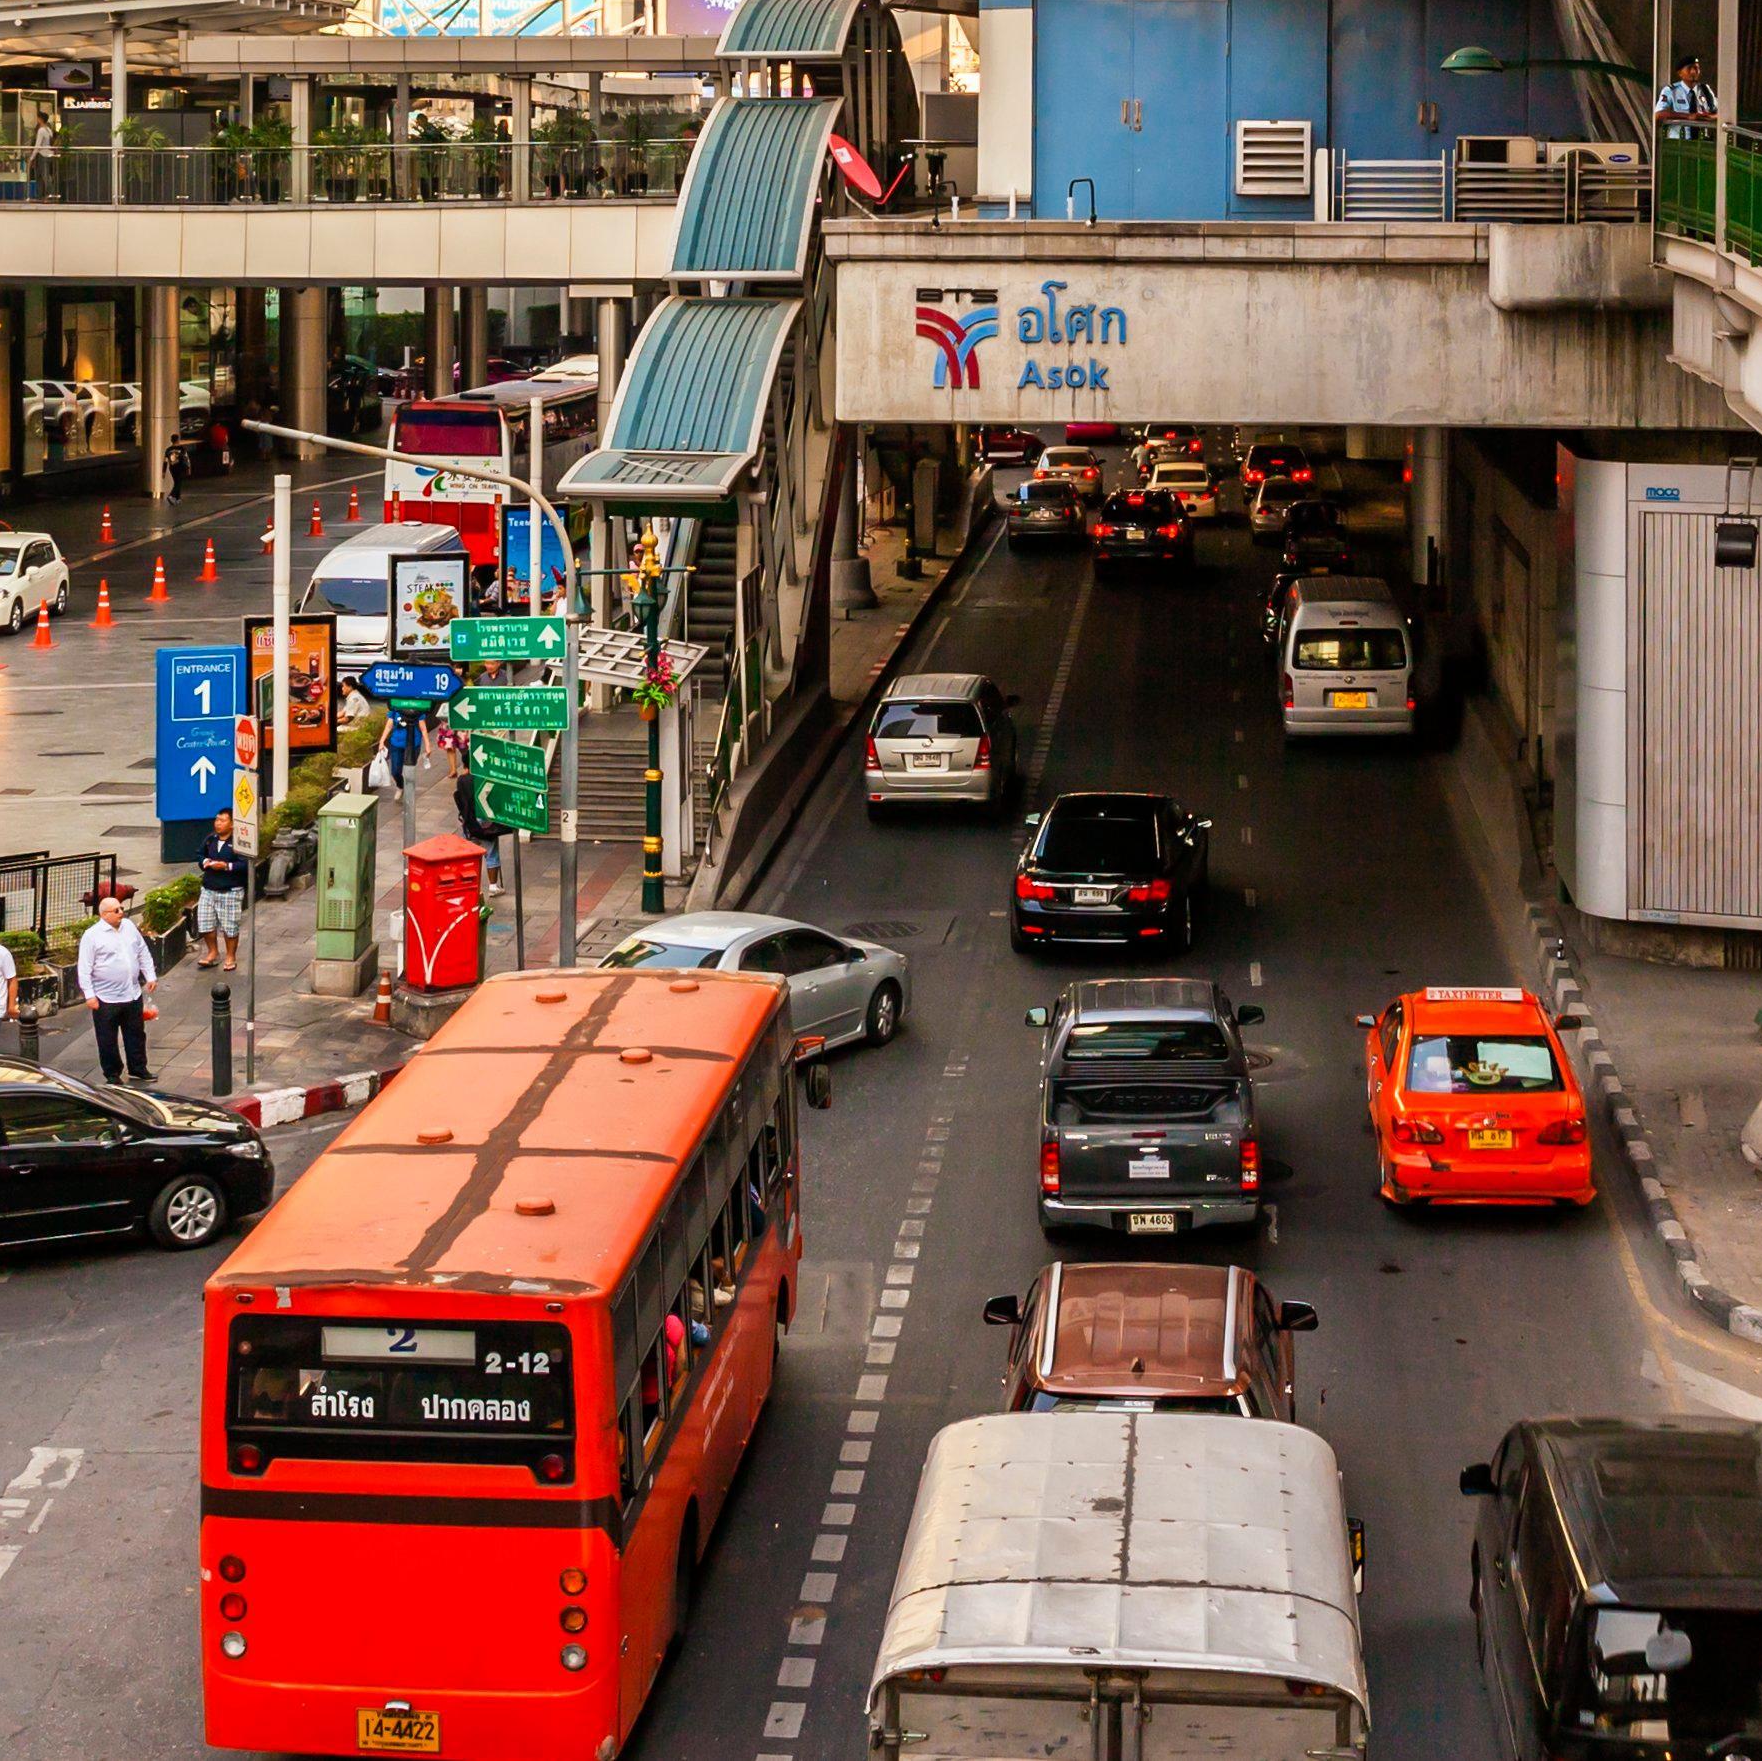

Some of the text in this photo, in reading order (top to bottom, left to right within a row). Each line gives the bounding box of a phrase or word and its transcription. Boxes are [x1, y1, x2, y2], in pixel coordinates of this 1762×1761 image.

[916, 288, 999, 303] BTS
[1017, 279, 1128, 345] อโศก
[1017, 358, 1110, 390] Asok
[407, 583, 435, 594] STEAK
[176, 663, 231, 675] ENTRANCE
[375, 667, 414, 683] สุขุมวิท
[435, 673, 450, 690] 19
[194, 680, 211, 715] 1
[482, 720, 513, 728] Embassy
[562, 812, 569, 823] 2
[1150, 1215, 1173, 1225] 4603
[387, 1328, 418, 1352] 2
[485, 1352, 551, 1374] 2-12
[311, 1386, 531, 1422] สำโรง ปากคลอง
[365, 1719, 435, 1741] 14-4422
